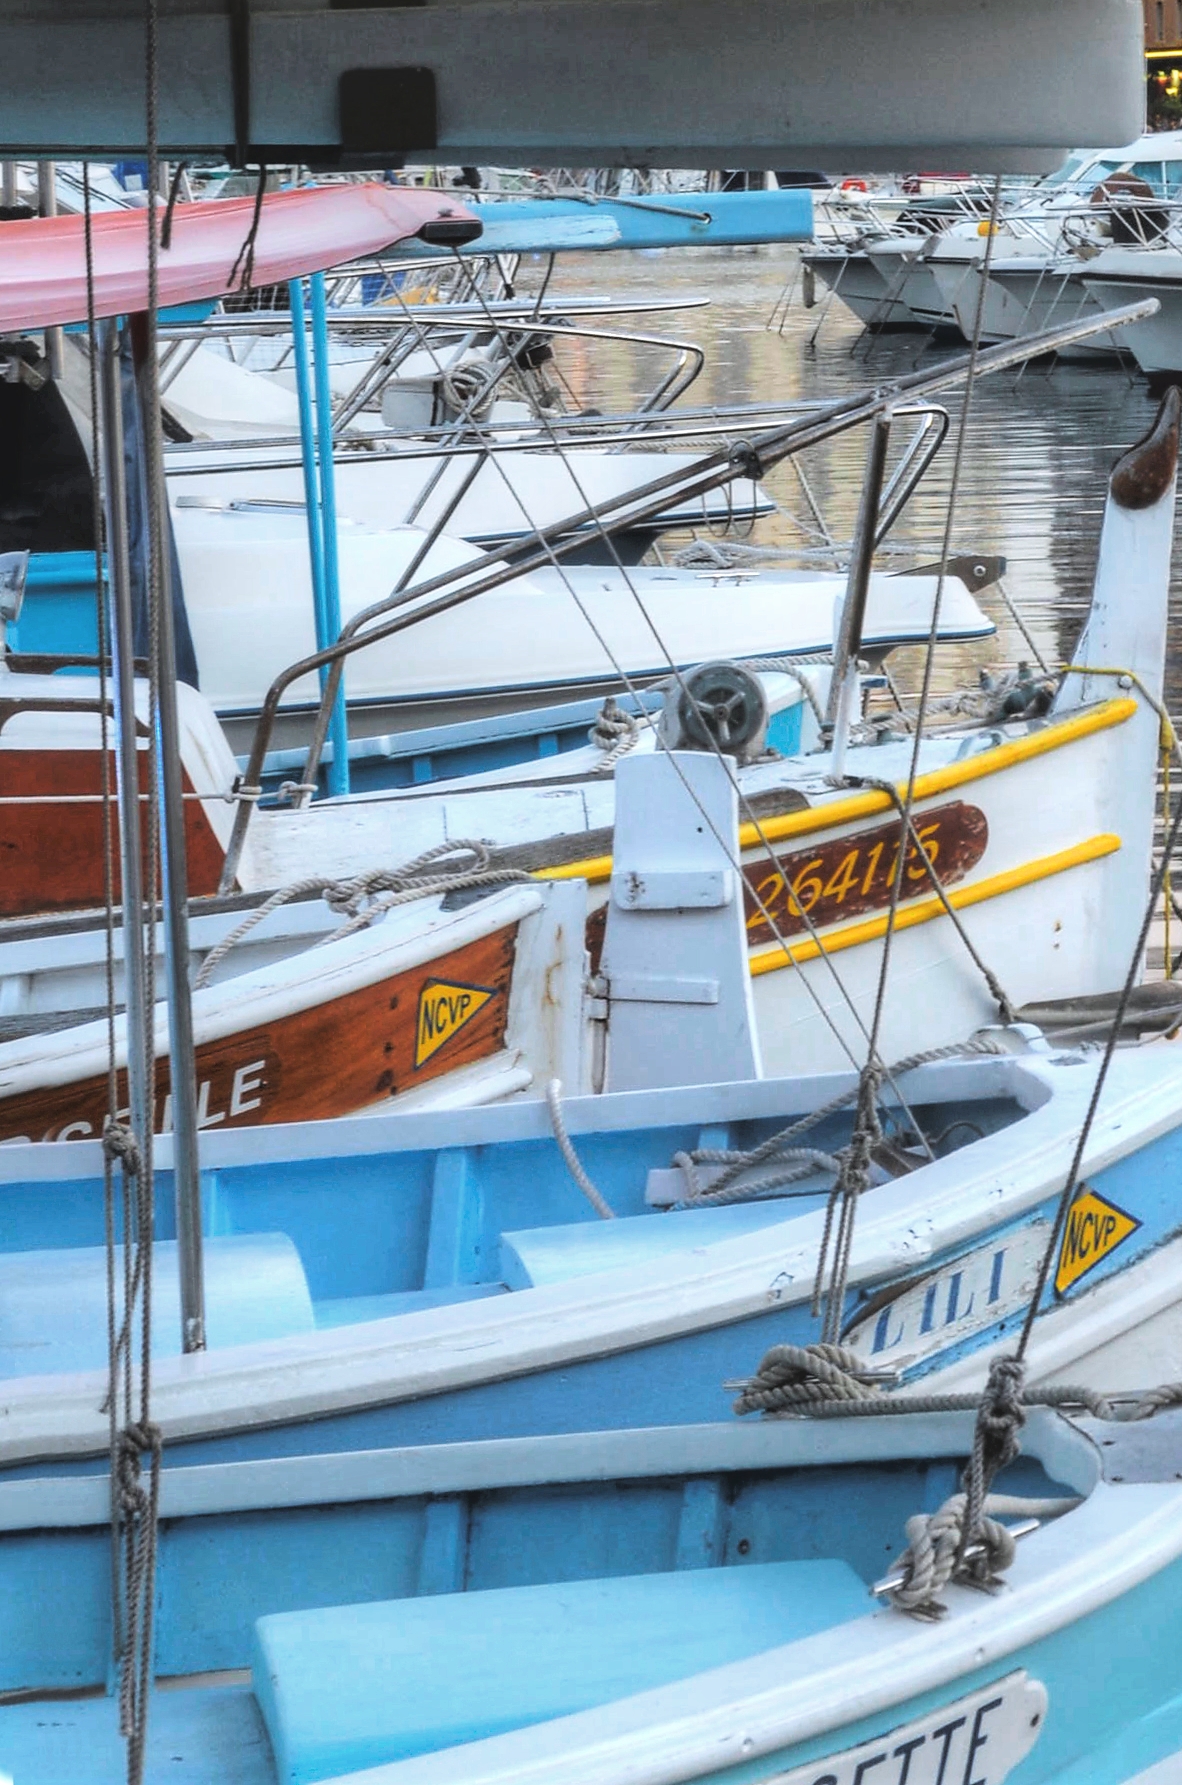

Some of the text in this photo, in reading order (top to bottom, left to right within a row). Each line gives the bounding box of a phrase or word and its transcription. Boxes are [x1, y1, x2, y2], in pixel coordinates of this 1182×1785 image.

[420, 994, 471, 1045] NCVP
[1063, 1210, 1117, 1268] NCVP
[871, 1247, 1010, 1355] LILI
